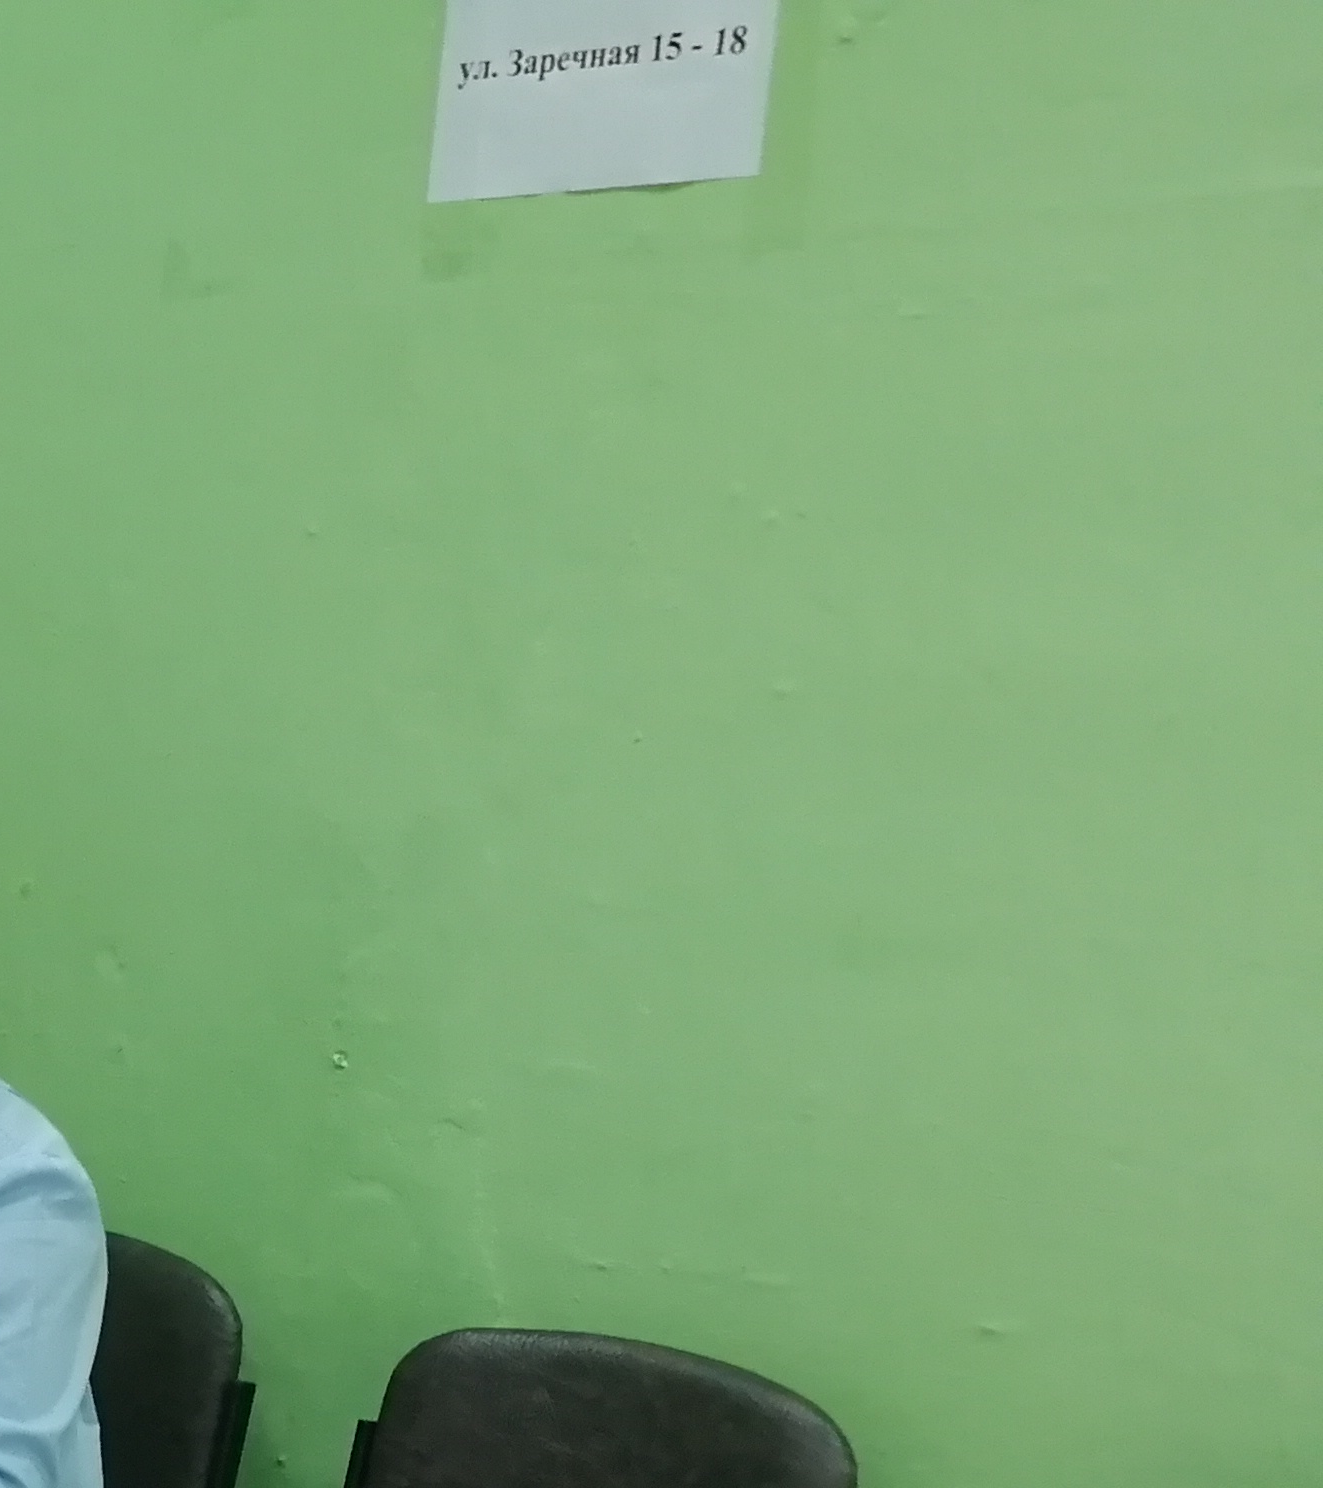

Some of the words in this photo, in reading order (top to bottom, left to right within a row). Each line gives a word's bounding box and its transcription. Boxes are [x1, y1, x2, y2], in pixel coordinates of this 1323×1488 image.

[457, 59, 499, 90] ул.
[506, 42, 641, 82] Заречная
[651, 31, 683, 62] 15
[713, 24, 748, 57] 18
